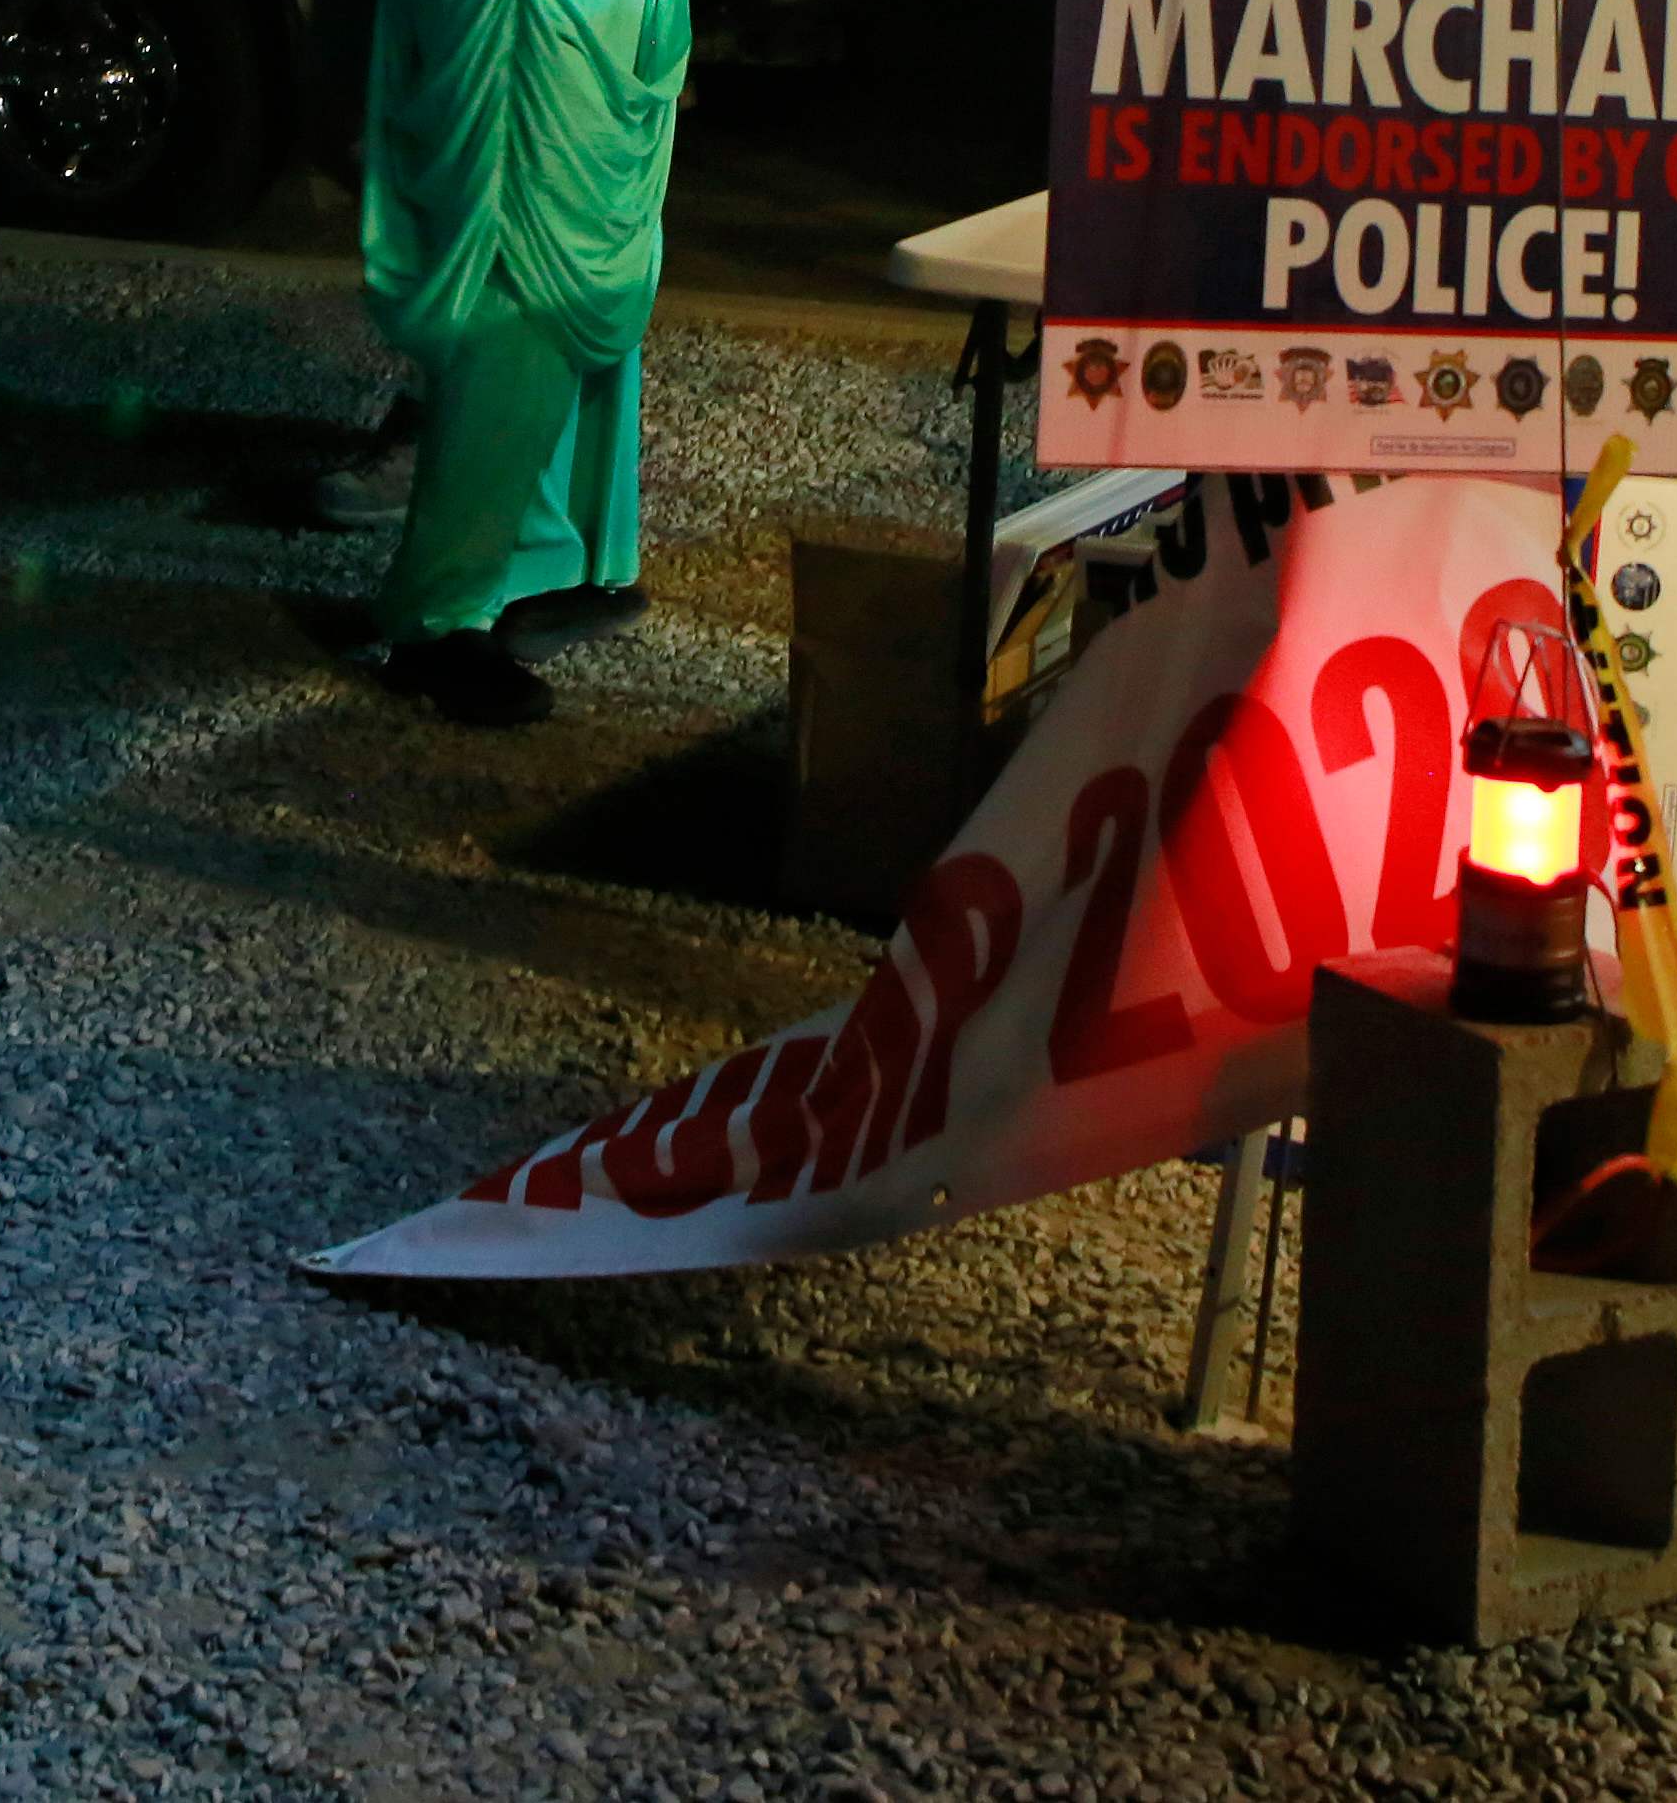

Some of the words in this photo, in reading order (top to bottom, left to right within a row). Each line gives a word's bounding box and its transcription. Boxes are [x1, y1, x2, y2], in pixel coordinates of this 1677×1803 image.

[1088, 104, 1151, 181] IS
[1178, 109, 1542, 195] ENDORSED
[1561, 126, 1652, 199] BY
[1262, 196, 1641, 322] POLICE!
